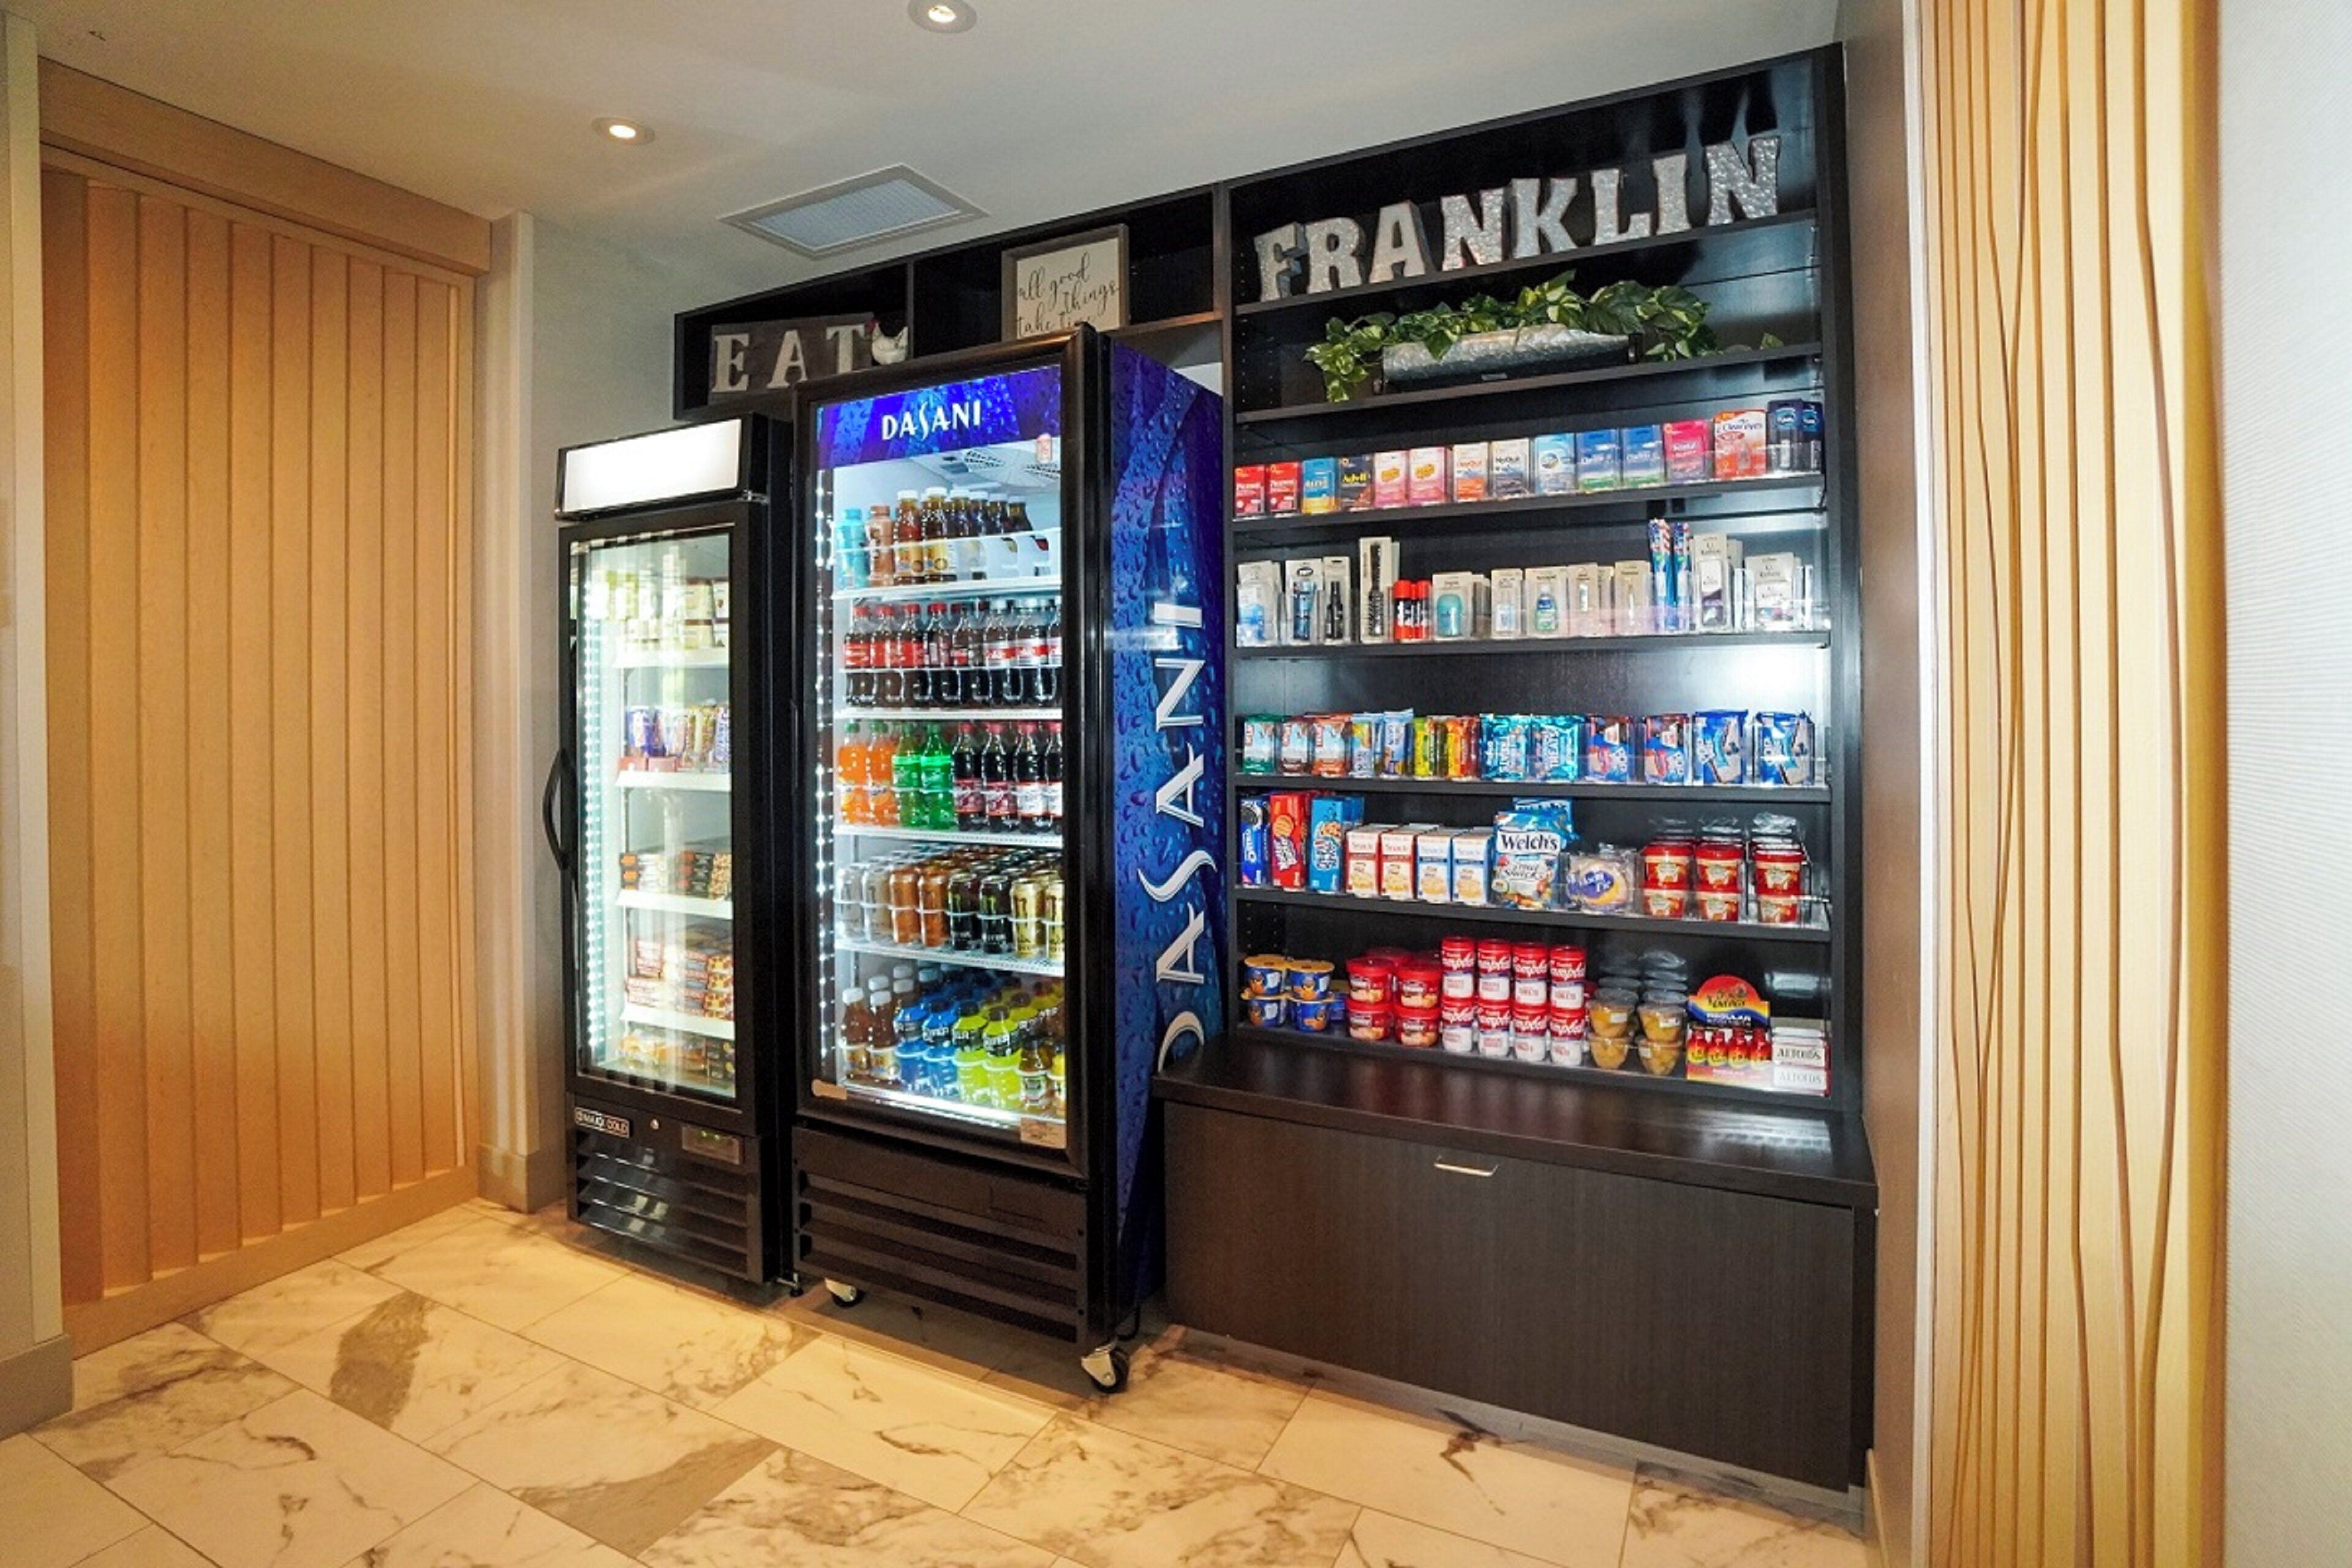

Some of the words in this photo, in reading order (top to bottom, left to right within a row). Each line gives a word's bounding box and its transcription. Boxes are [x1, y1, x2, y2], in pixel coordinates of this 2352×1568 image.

[1254, 135, 1781, 302] FRANKLIN
[1019, 266, 1046, 301] all
[1048, 251, 1091, 312] good
[1016, 301, 1054, 337] take
[711, 323, 866, 393] EAT
[881, 399, 982, 441] DASANI
[1137, 603, 1217, 1074] DASANI
[1501, 833, 1559, 851] Welch's
